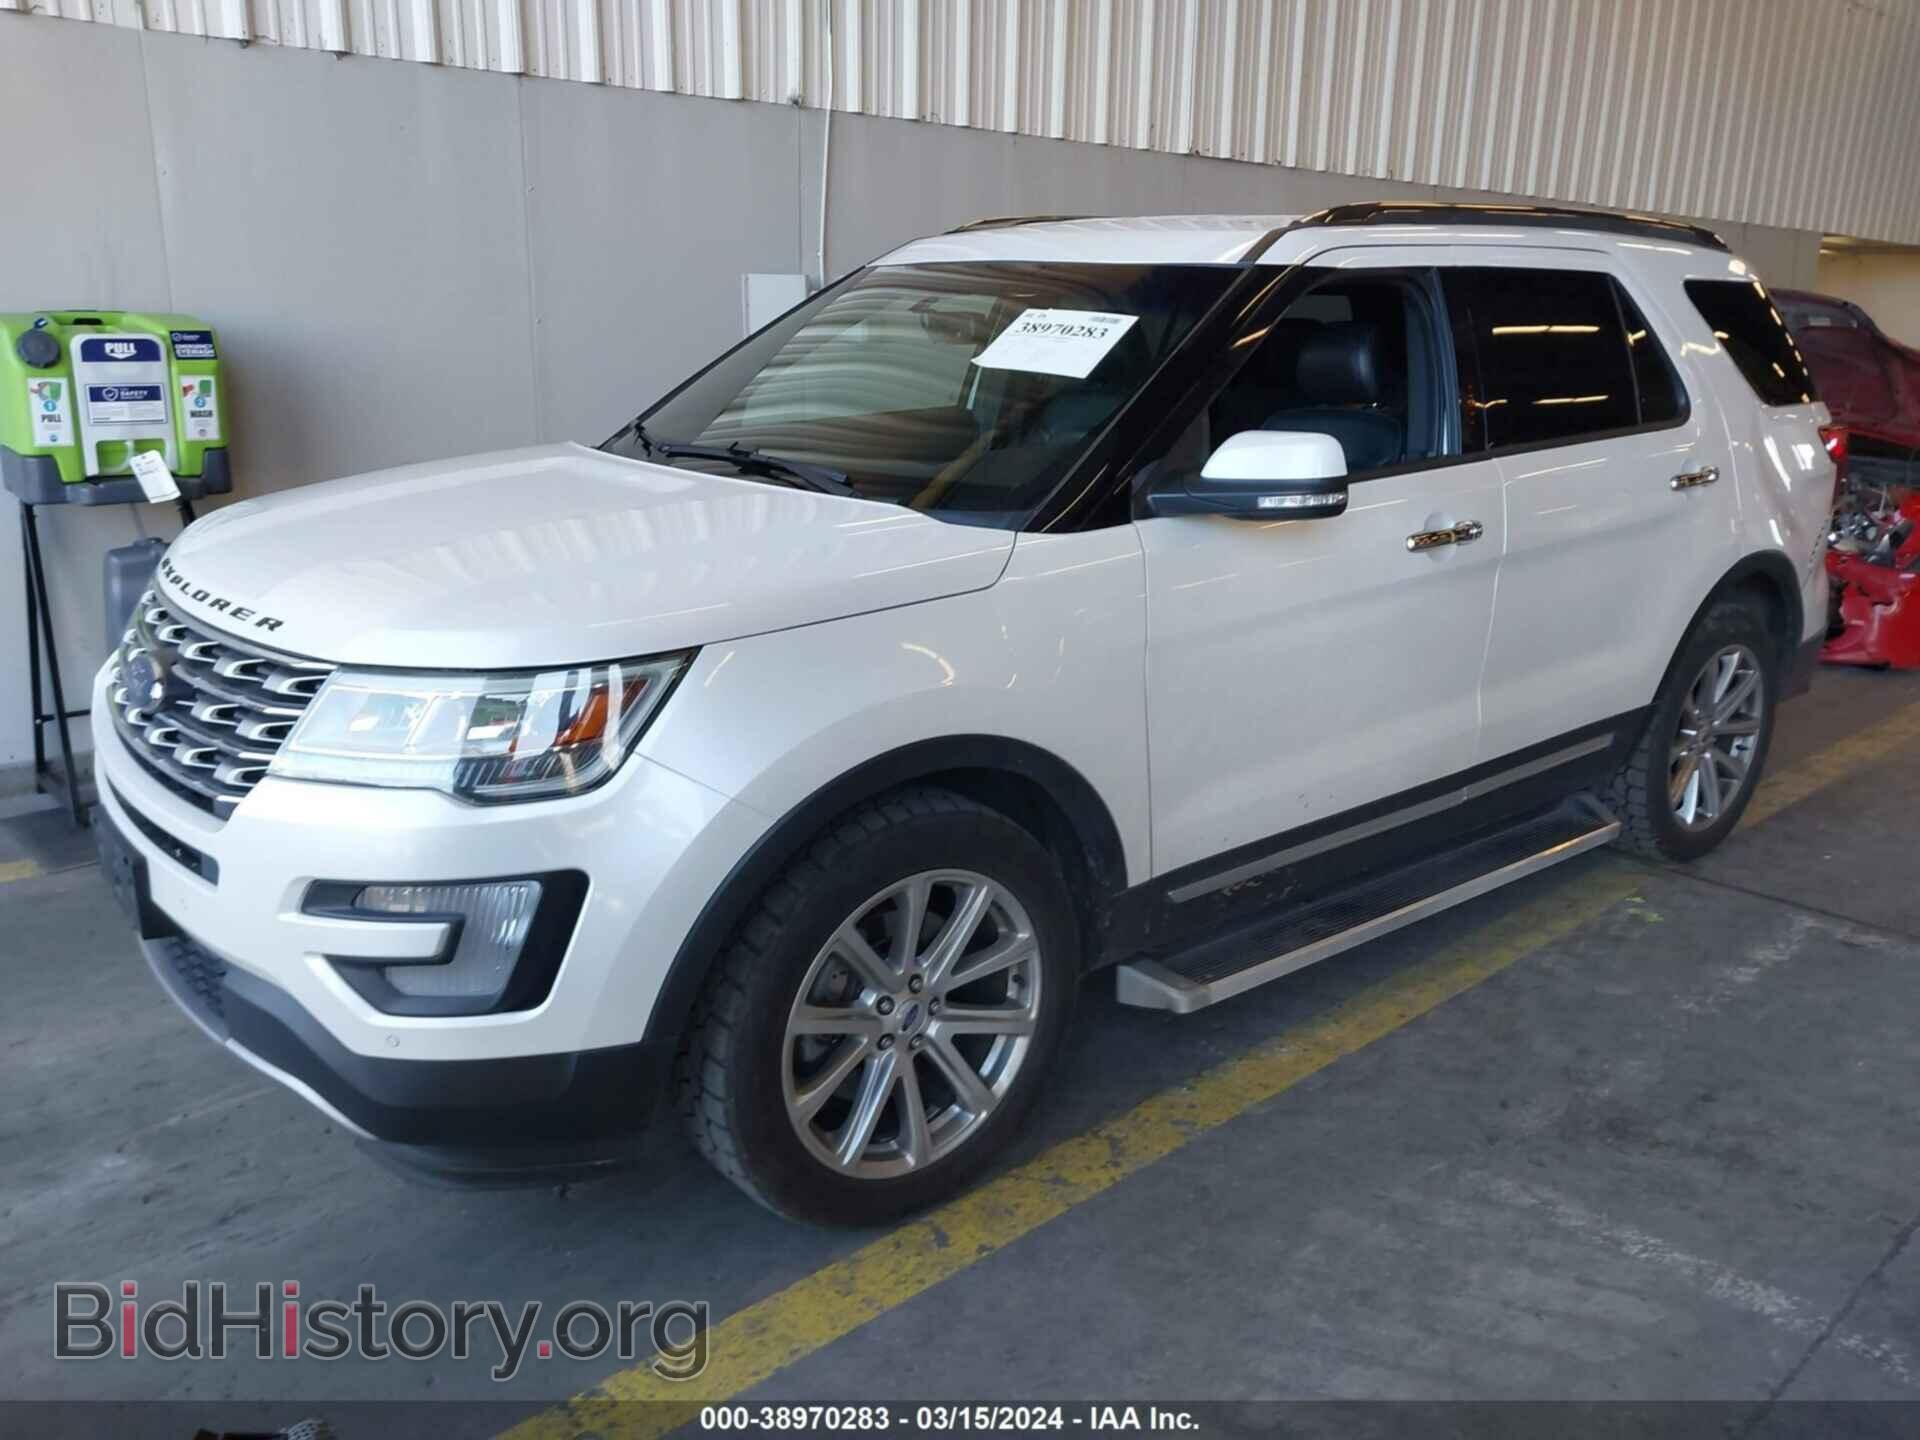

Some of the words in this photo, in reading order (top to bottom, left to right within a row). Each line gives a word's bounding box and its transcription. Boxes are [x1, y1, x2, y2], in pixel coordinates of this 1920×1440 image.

[1015, 322, 1109, 339] 38970283
[104, 342, 137, 354] PULL
[41, 414, 62, 423] PULL
